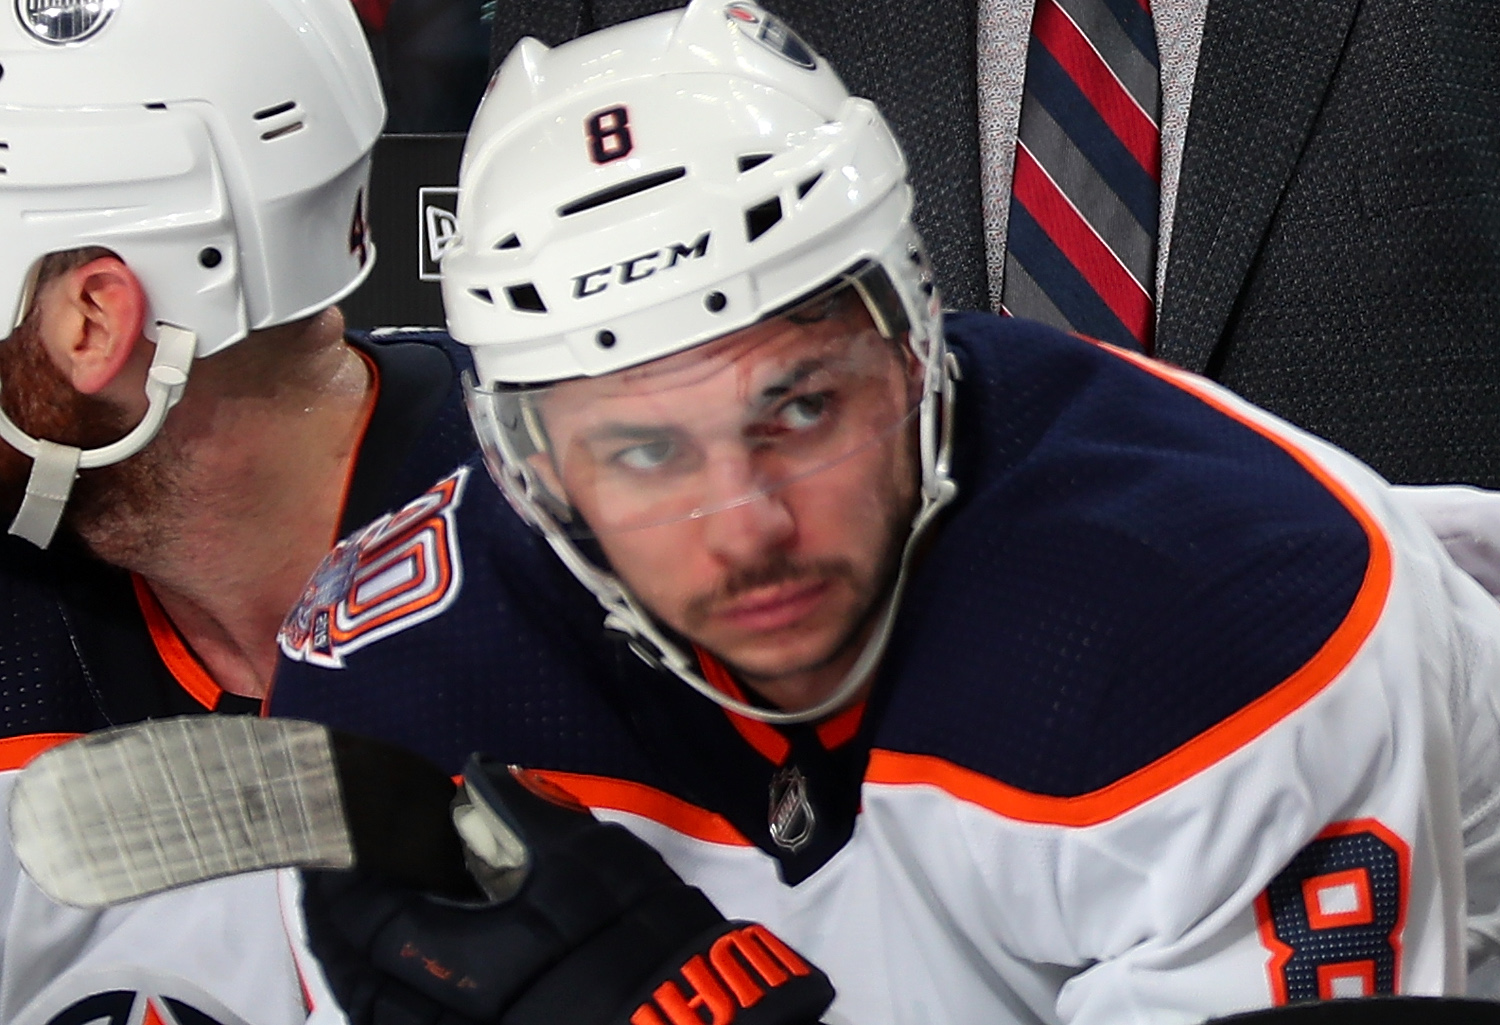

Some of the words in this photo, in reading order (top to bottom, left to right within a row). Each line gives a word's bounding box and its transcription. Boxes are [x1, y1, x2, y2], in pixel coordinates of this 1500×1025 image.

[585, 104, 634, 166] 8
[571, 231, 710, 299] CCM
[1254, 818, 1410, 1004] 8
[629, 924, 812, 1025] WA
